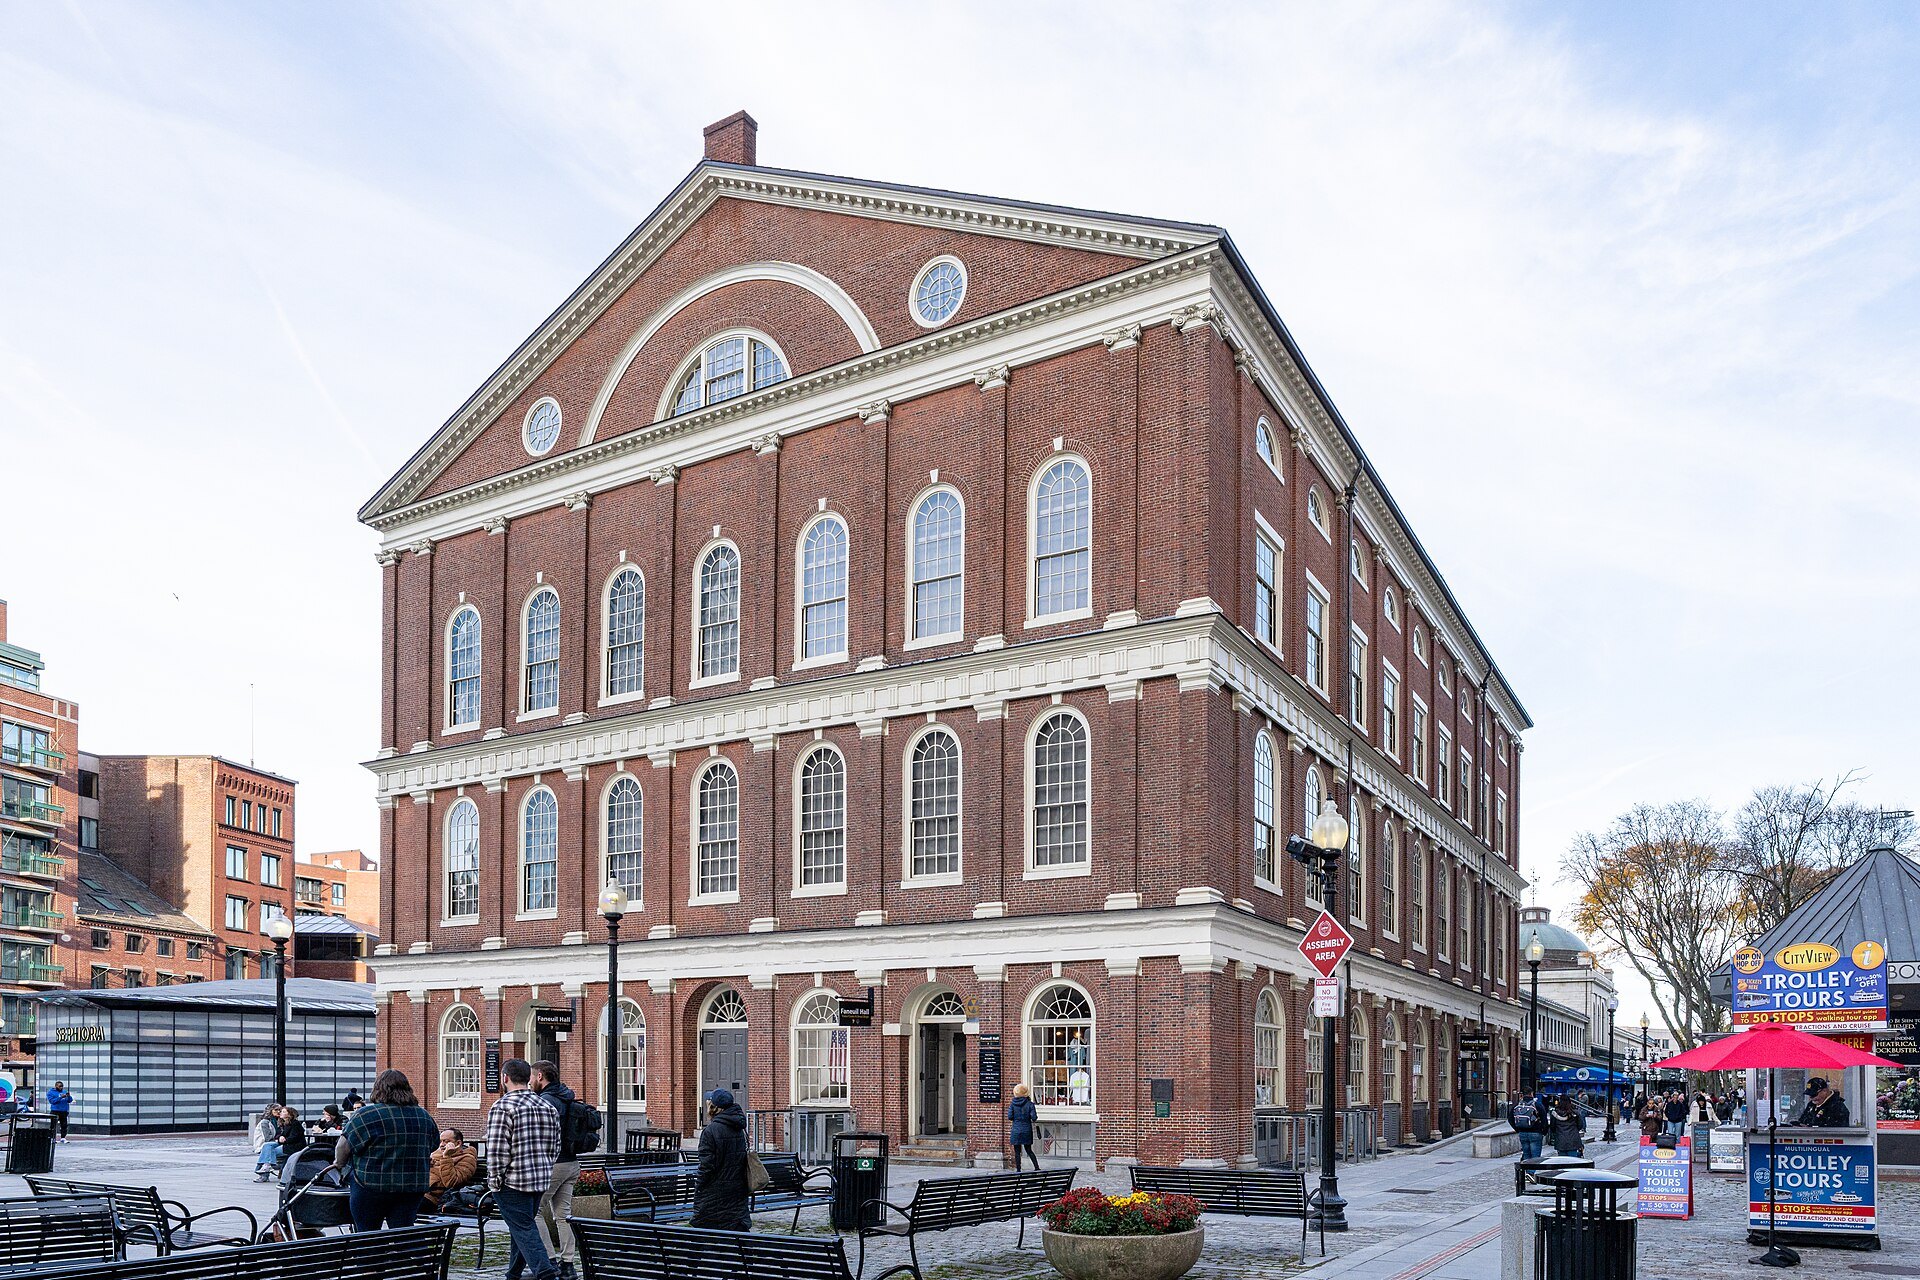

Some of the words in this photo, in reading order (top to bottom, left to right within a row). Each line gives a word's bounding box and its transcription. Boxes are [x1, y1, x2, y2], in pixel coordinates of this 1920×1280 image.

[1306, 938, 1345, 950] ASSEMBLY
[1315, 952, 1336, 961] AREA
[1762, 970, 1854, 990] TROLLEY
[1772, 990, 1845, 1008] TOURS
[1753, 1014, 1768, 1023] 50
[1773, 1012, 1814, 1022] STOPS
[56, 1026, 105, 1041] SEPHORA
[1766, 1155, 1851, 1170] TROLLEY
[1642, 1168, 1685, 1177] TROLLEY
[1646, 1178, 1681, 1186] TOURS
[1775, 1172, 1843, 1188] TOURS
